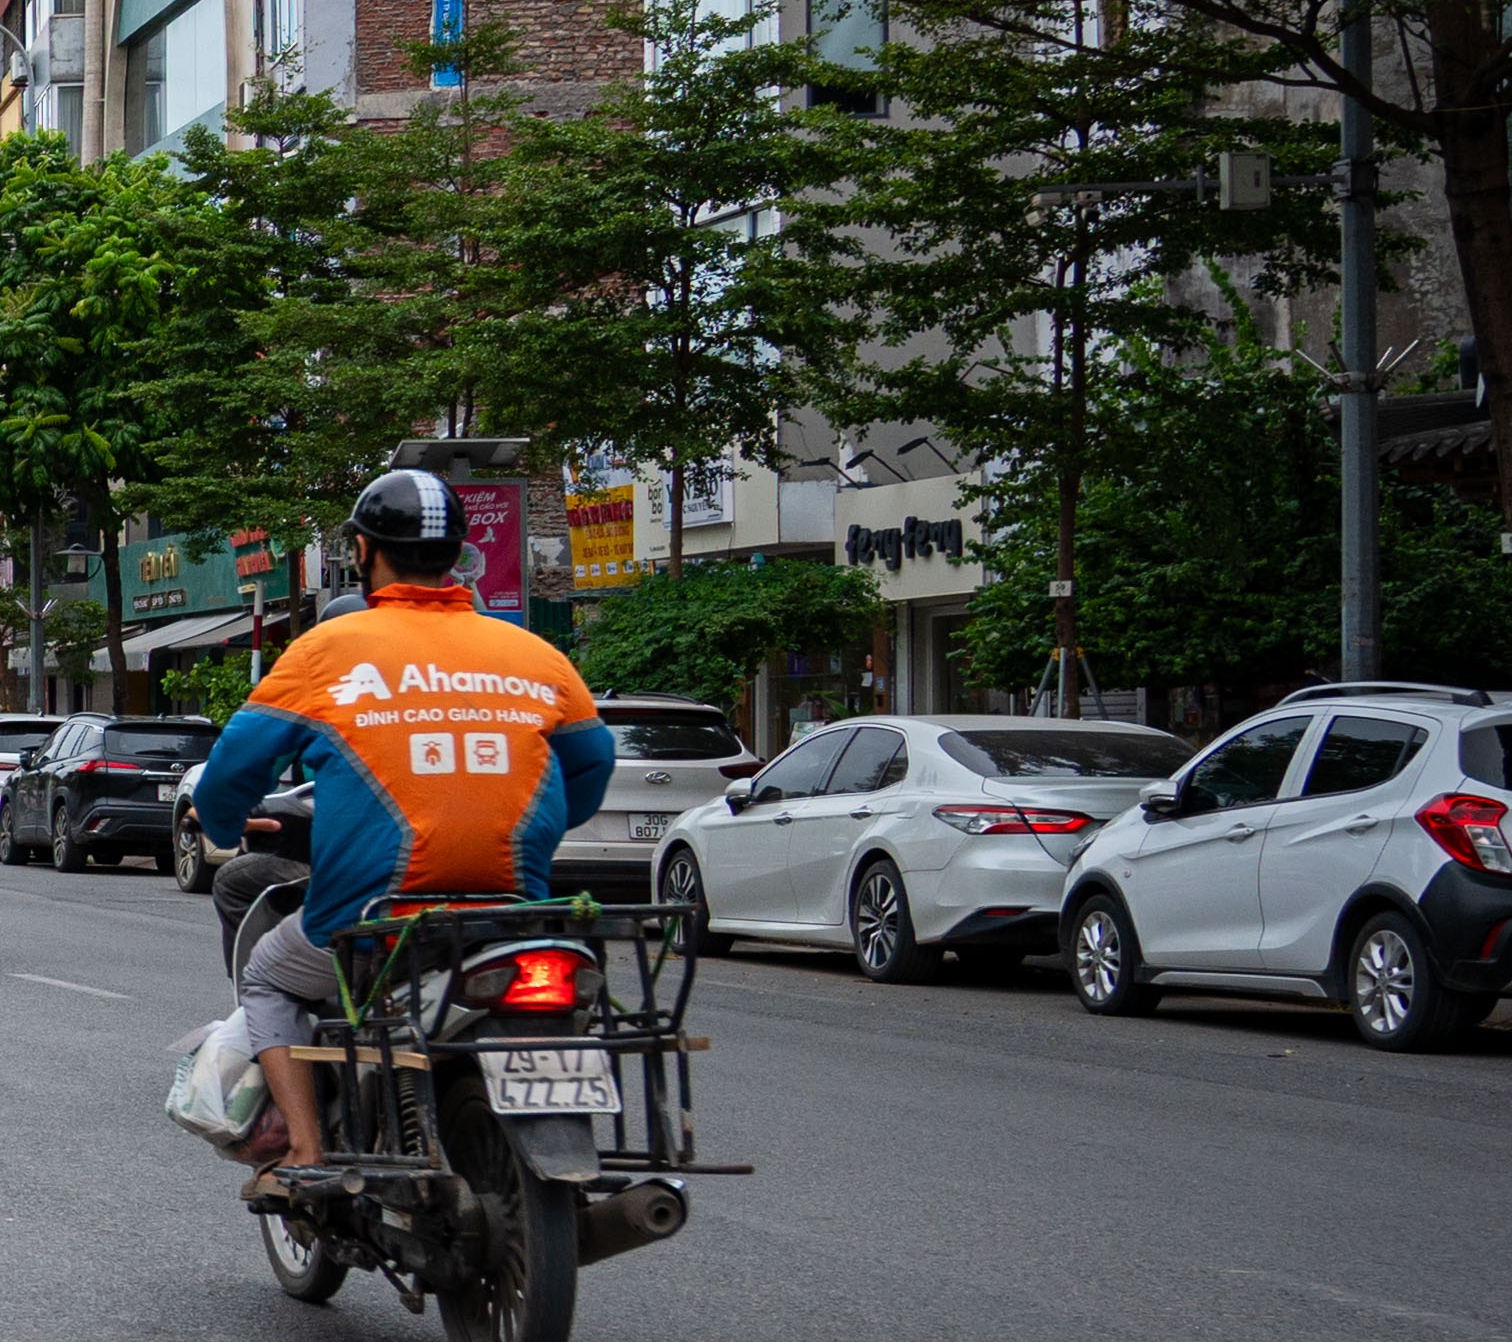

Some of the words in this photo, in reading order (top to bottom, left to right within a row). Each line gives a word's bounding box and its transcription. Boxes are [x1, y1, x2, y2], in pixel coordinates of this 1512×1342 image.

[469, 511, 509, 526] BOX
[398, 663, 557, 706] Ahamove
[403, 708, 444, 723] CAO
[448, 708, 493, 723] GIAO
[496, 707, 545, 727] HÀNG
[644, 814, 668, 826] 30G
